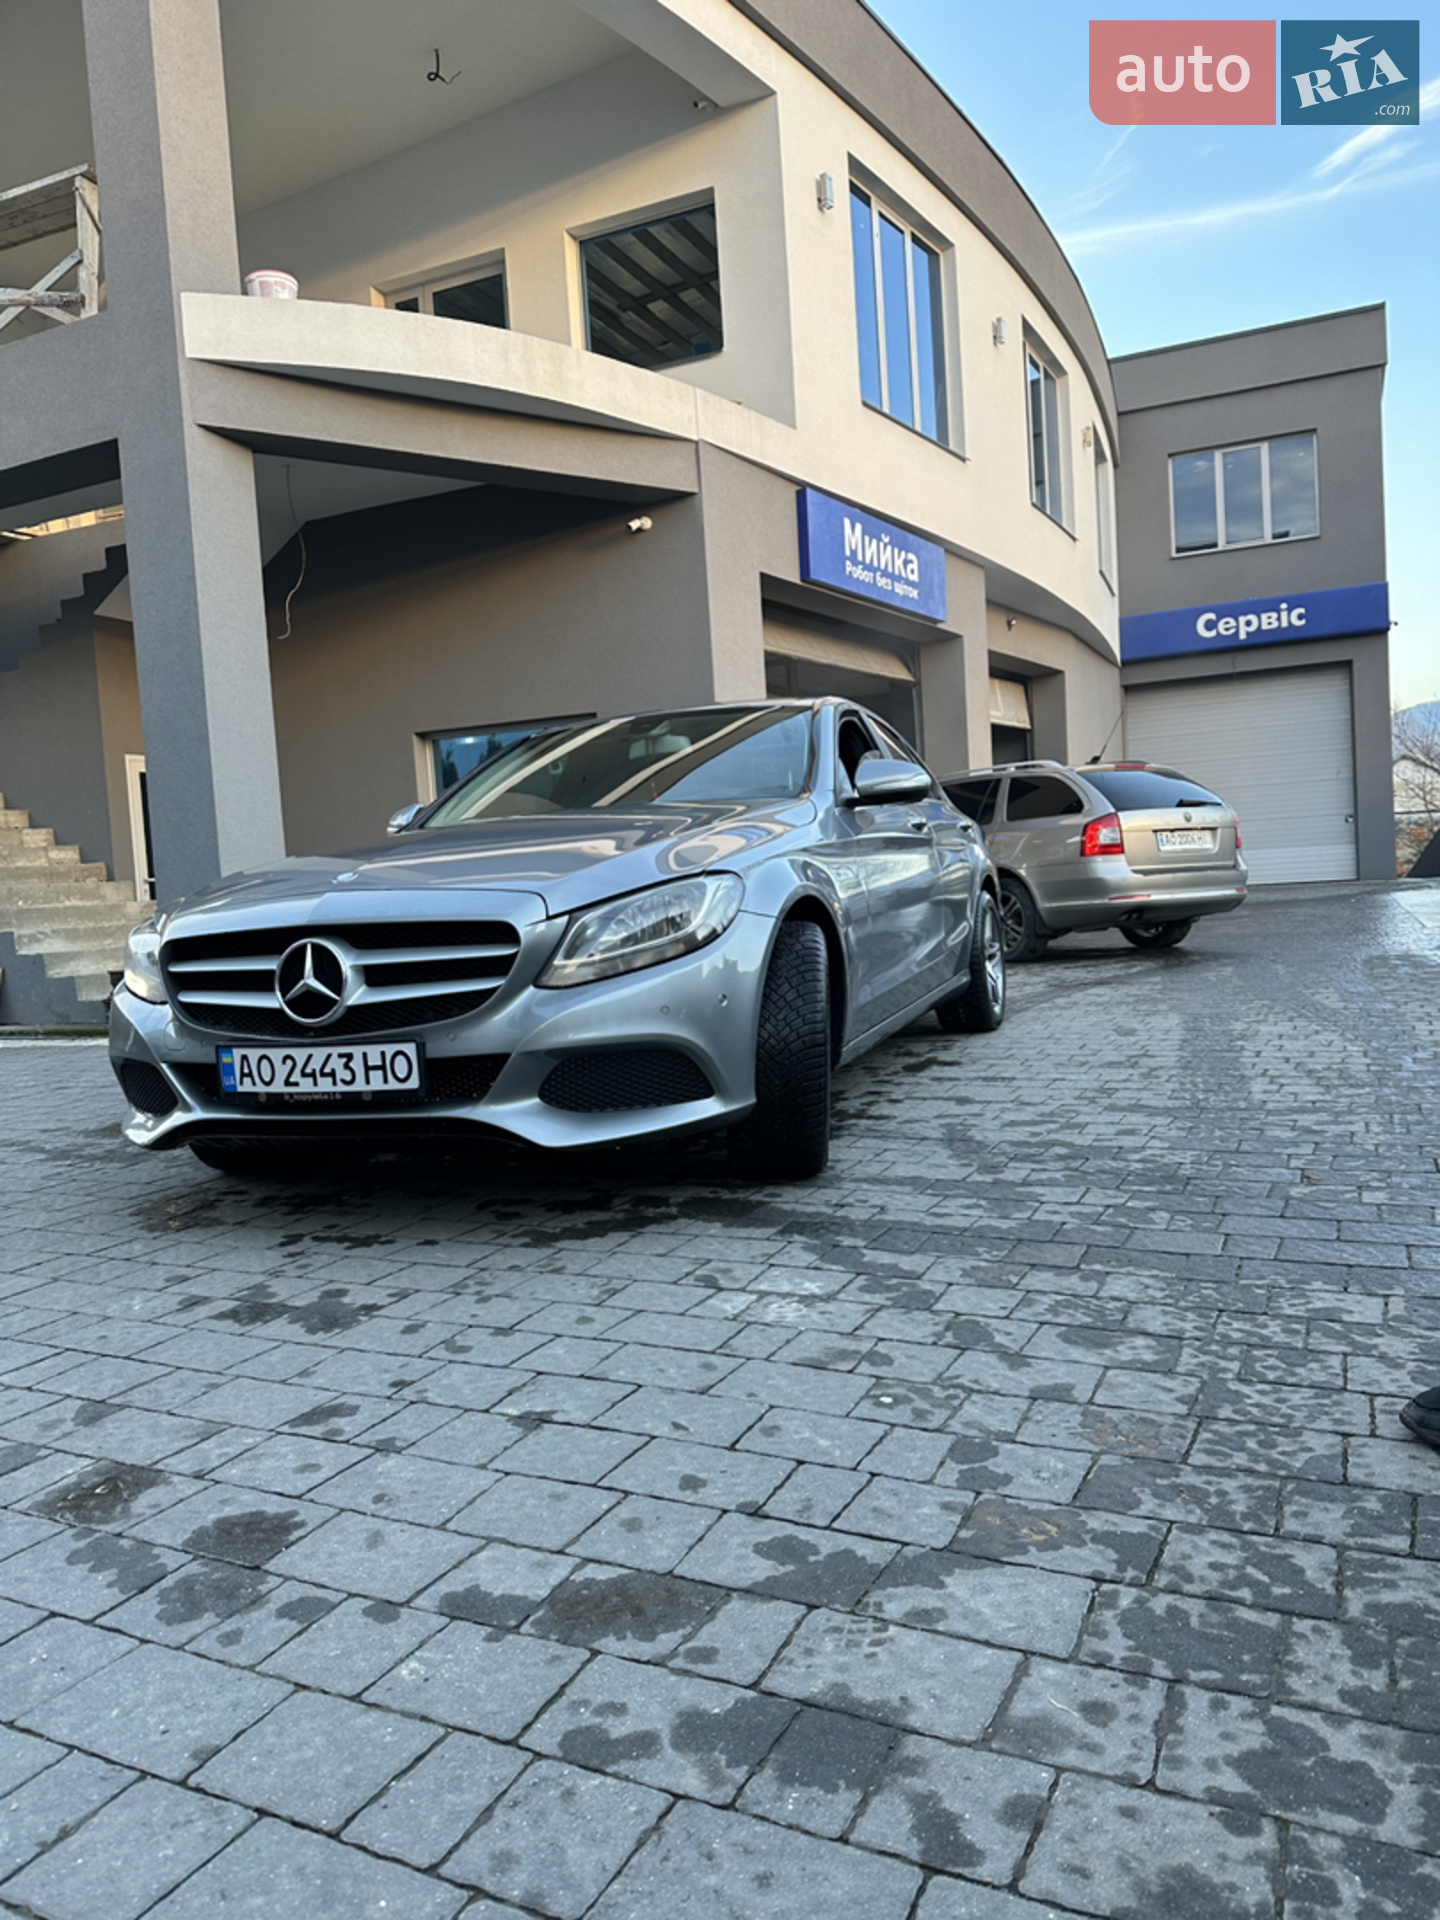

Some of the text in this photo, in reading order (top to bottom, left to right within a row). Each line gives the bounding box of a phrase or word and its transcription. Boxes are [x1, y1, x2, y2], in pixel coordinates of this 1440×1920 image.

[843, 516, 919, 583] Мийка
[845, 559, 920, 600] Робот без щіток
[1195, 602, 1307, 641] Сервіс
[223, 1075, 236, 1086] UA
